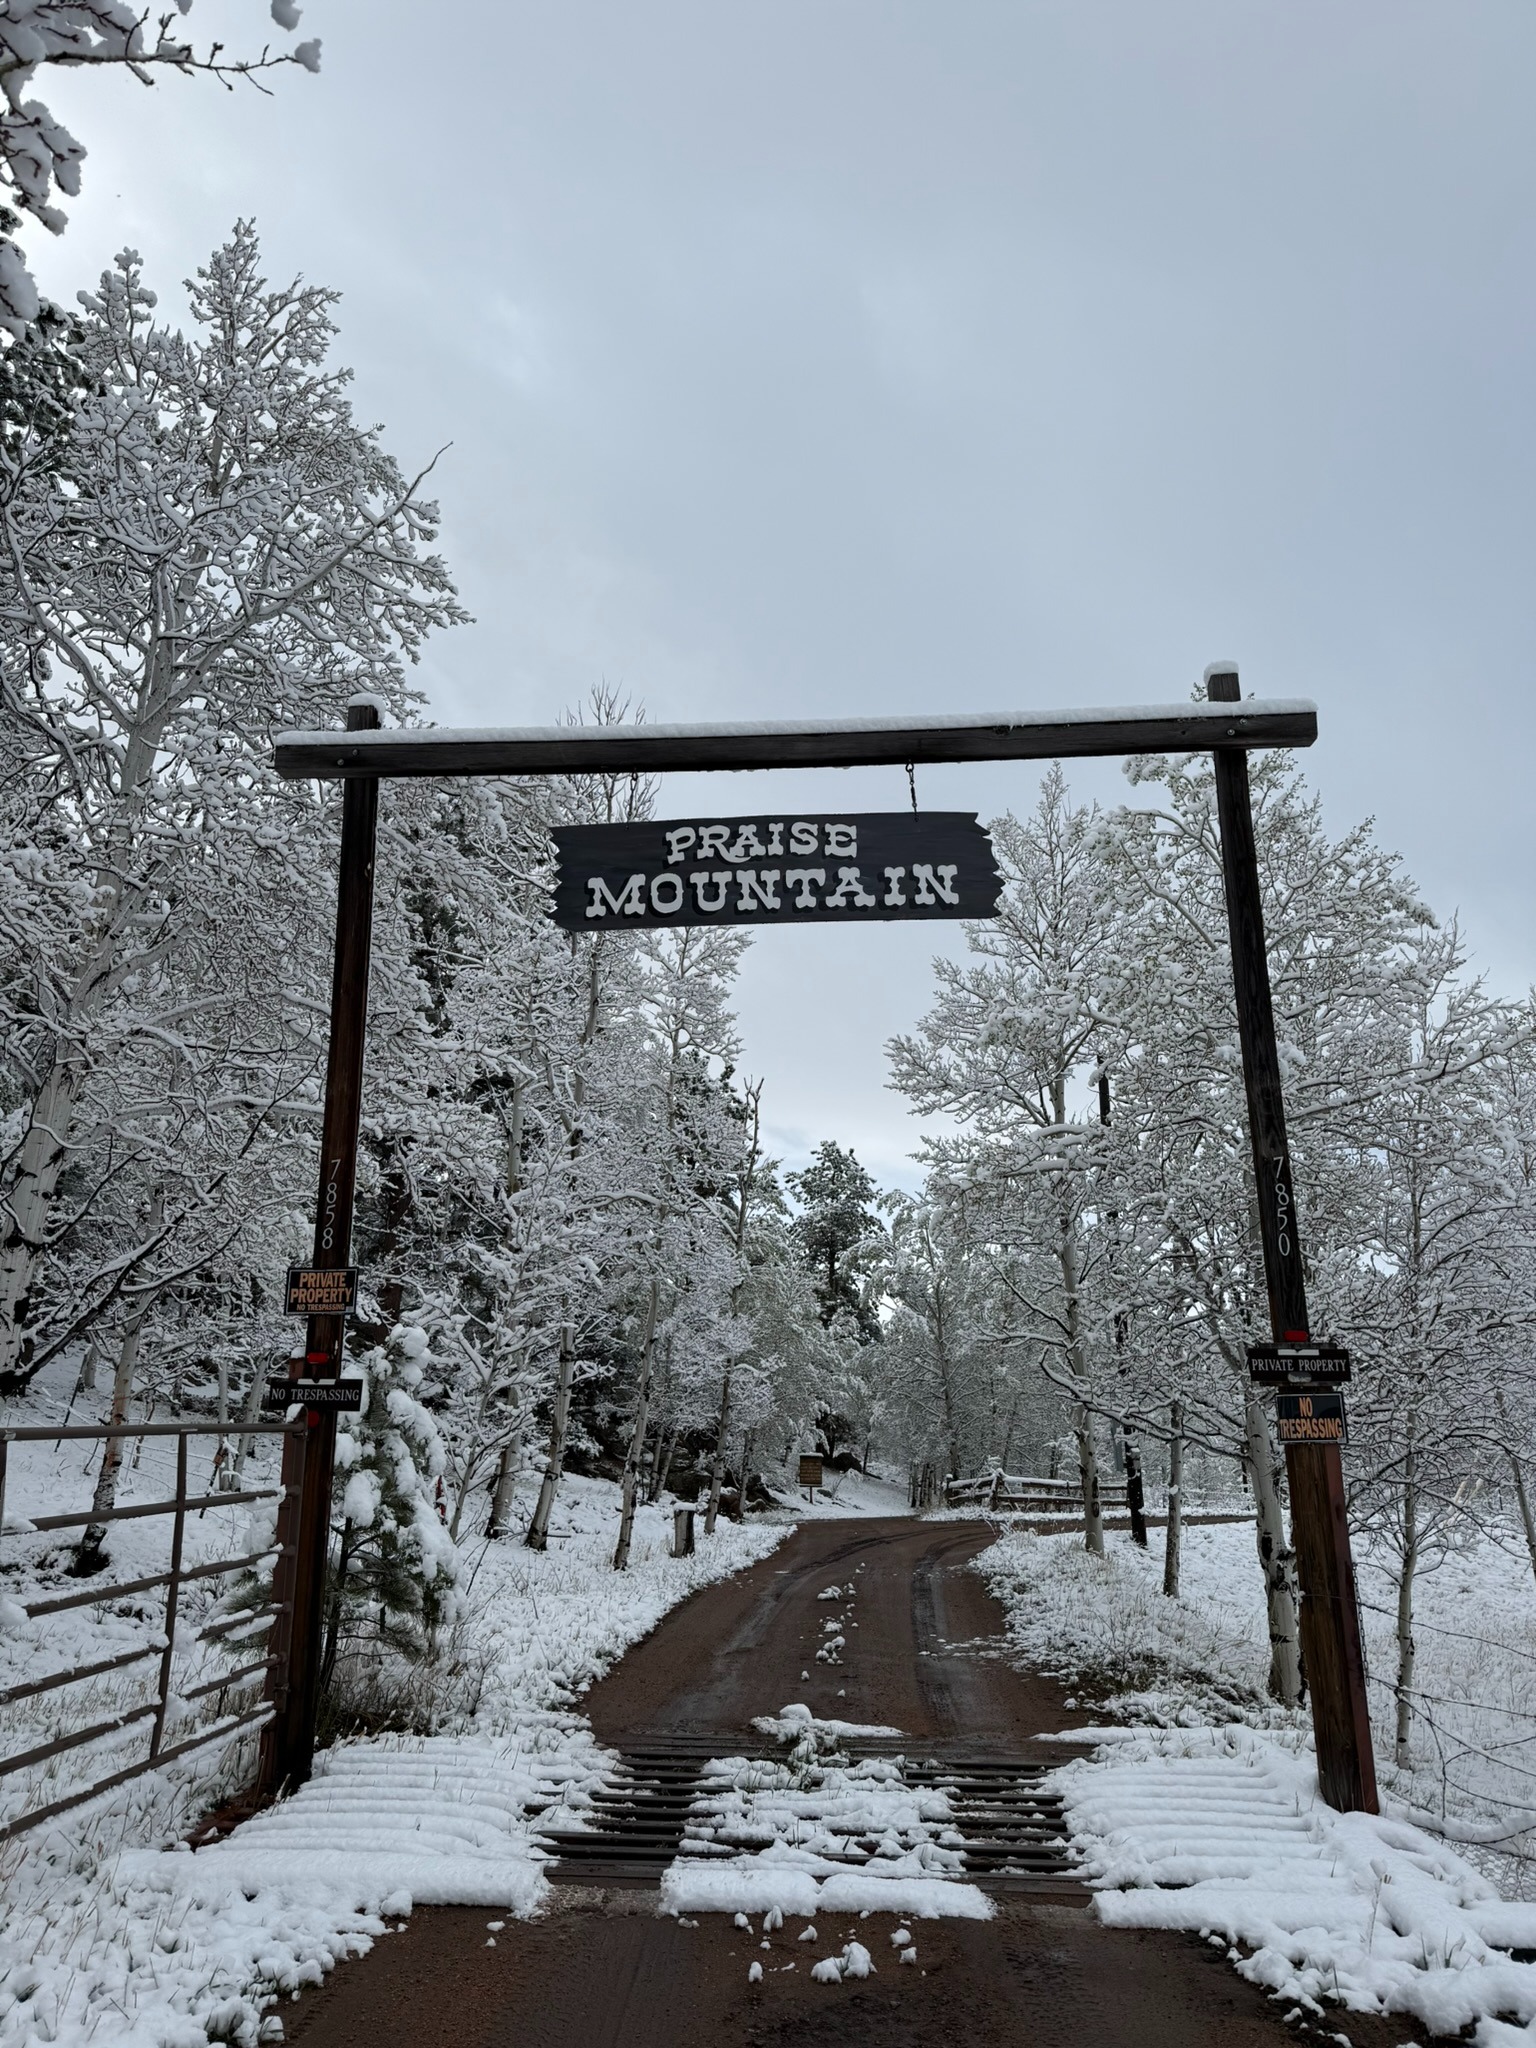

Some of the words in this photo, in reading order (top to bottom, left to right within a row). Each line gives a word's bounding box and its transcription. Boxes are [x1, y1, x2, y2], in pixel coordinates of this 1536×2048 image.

[664, 822, 858, 864] PRAISE
[585, 864, 960, 918] MOUNTAIN
[322, 1158, 341, 1249] 7858
[1273, 1156, 1290, 1256] 7850
[299, 1271, 347, 1288] PRIVATE
[290, 1287, 353, 1303] PROPERTY
[296, 1303, 306, 1311] NO
[307, 1303, 345, 1311] TRESPASSING
[1252, 1358, 1294, 1371] PRIVATE
[1299, 1359, 1347, 1372] PROPERTY
[271, 1388, 286, 1400] NO
[291, 1388, 360, 1401] TRESPASSING
[1299, 1397, 1313, 1417] NO
[1279, 1418, 1343, 1439] TRESPASSING
